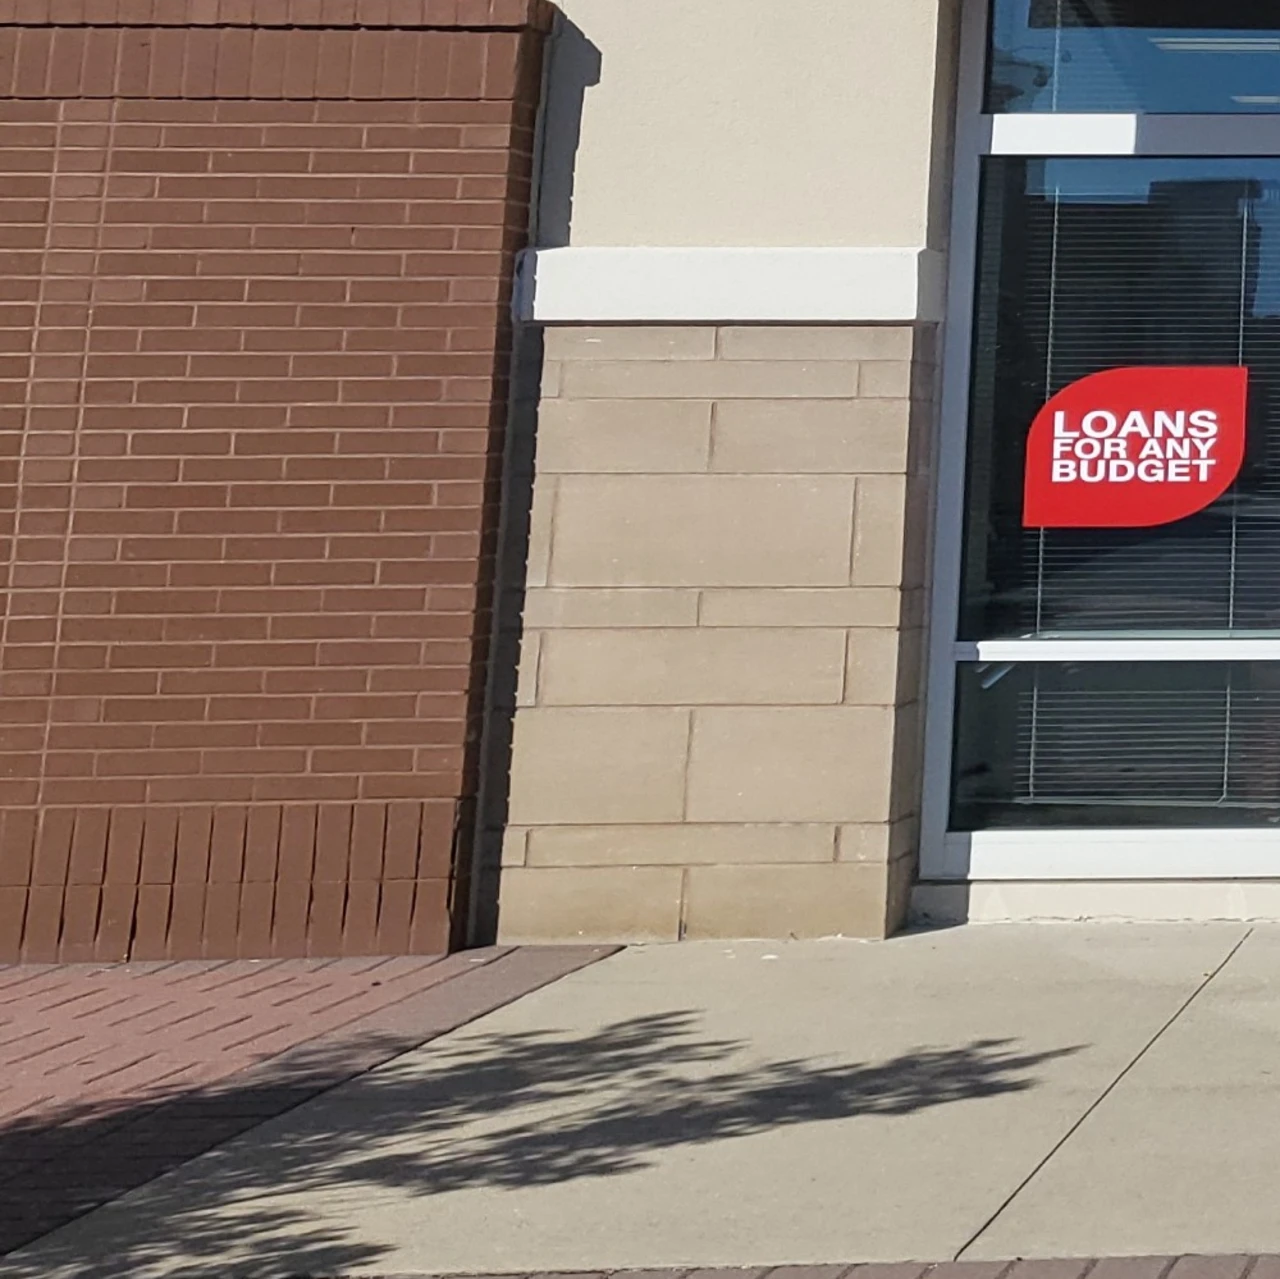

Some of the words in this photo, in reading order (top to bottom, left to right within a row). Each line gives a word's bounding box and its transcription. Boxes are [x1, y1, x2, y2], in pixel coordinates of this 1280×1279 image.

[1053, 410, 1218, 439] LOANS
[1052, 438, 1127, 459] FOR
[1138, 438, 1217, 459] ANY
[1051, 459, 1217, 483] BUDGET
